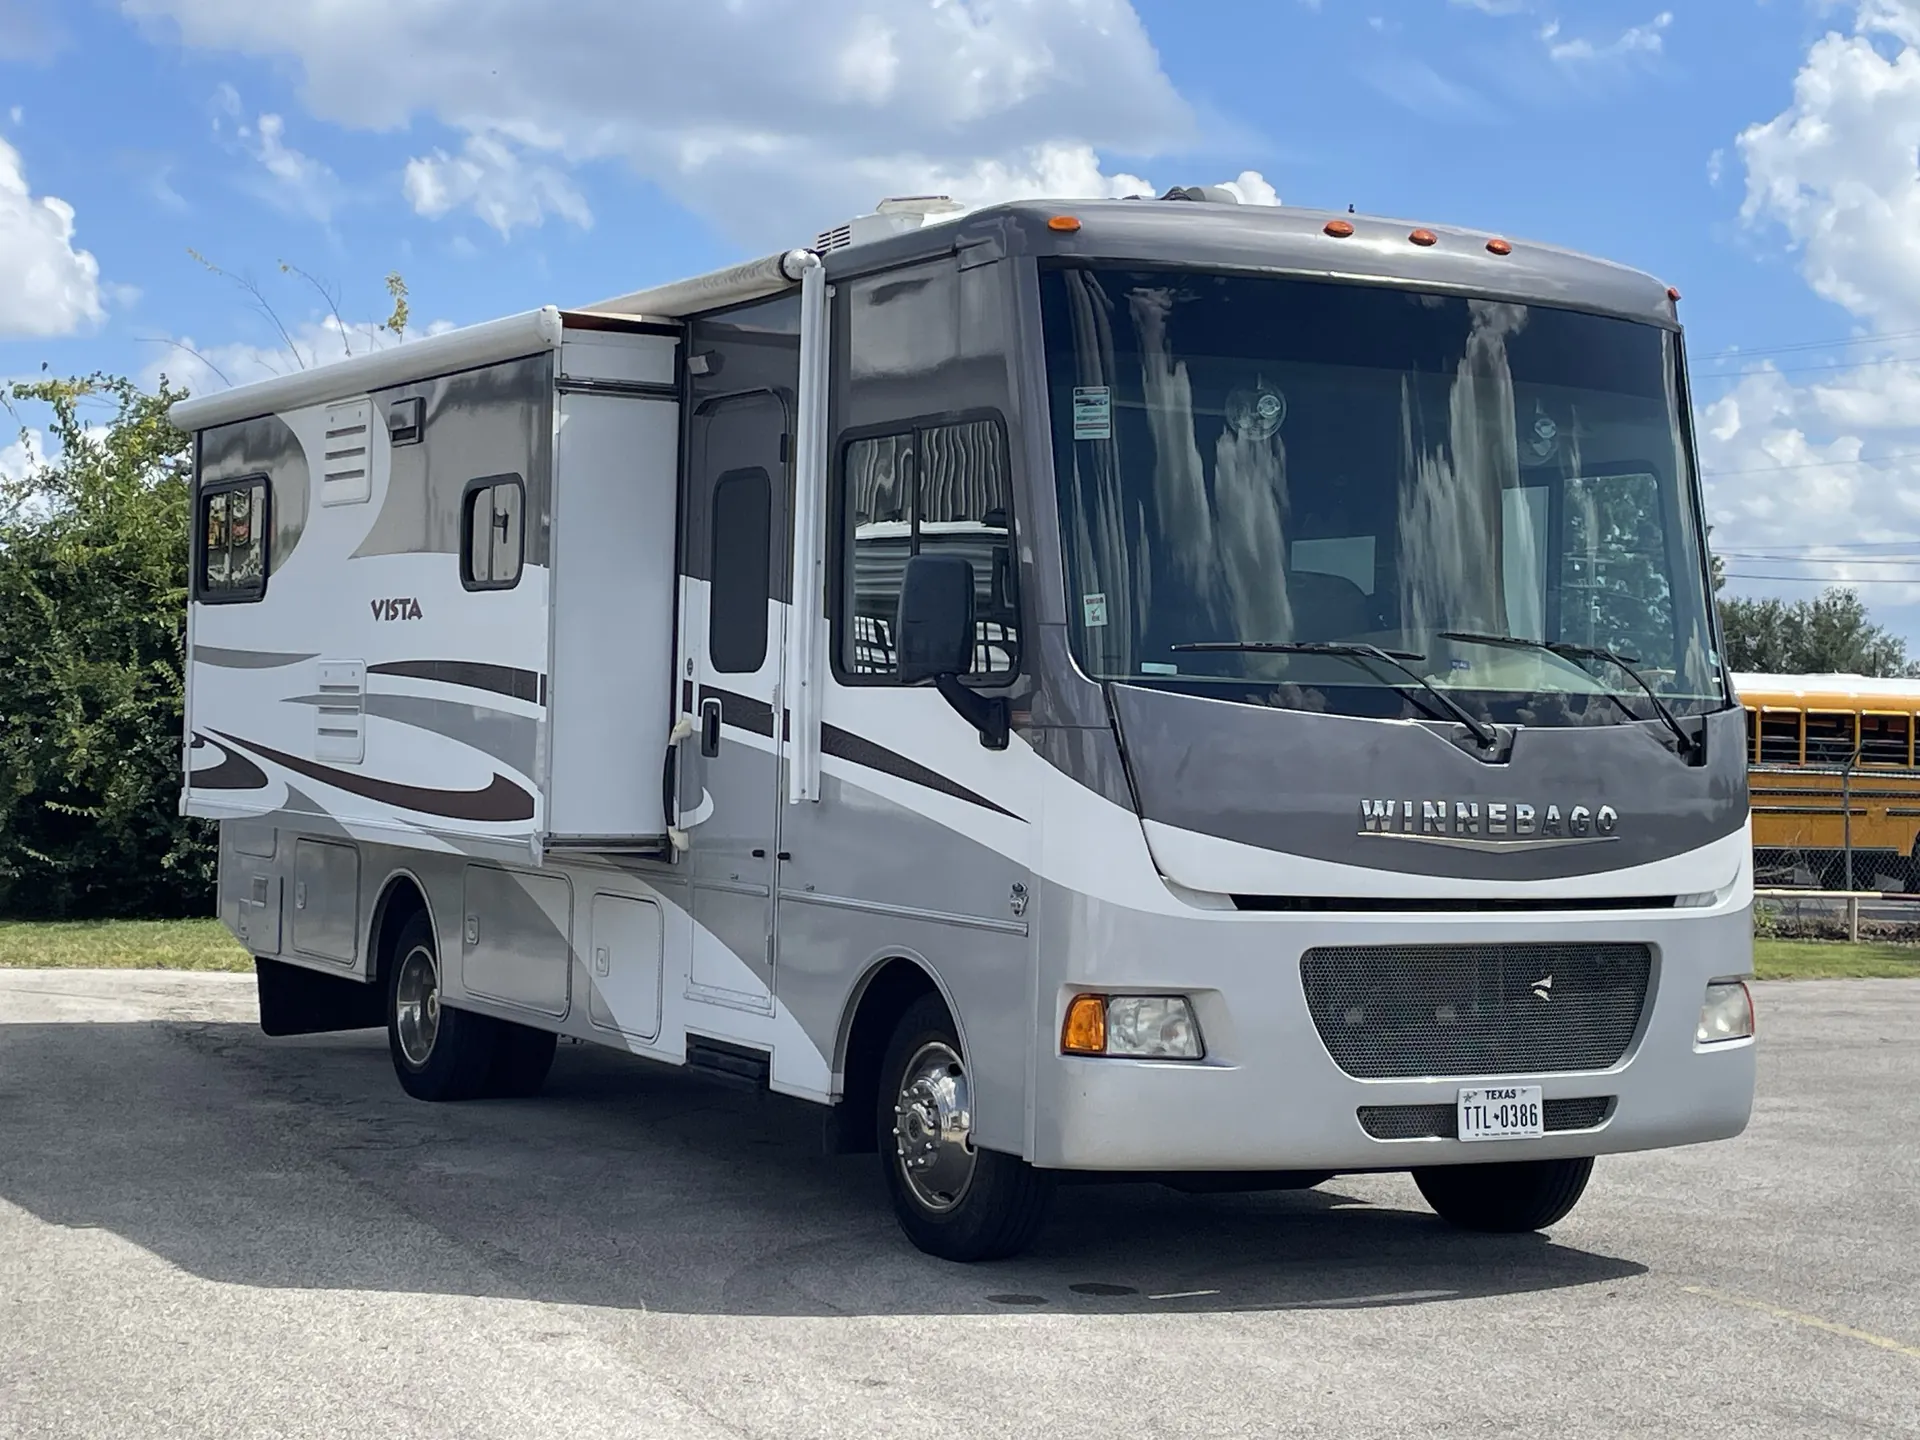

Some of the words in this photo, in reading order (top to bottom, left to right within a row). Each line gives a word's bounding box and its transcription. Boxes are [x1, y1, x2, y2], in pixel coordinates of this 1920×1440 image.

[370, 597, 423, 622] VISTA
[1361, 799, 1619, 836] WINNEBAGO
[1484, 1089, 1517, 1100] TEXAS
